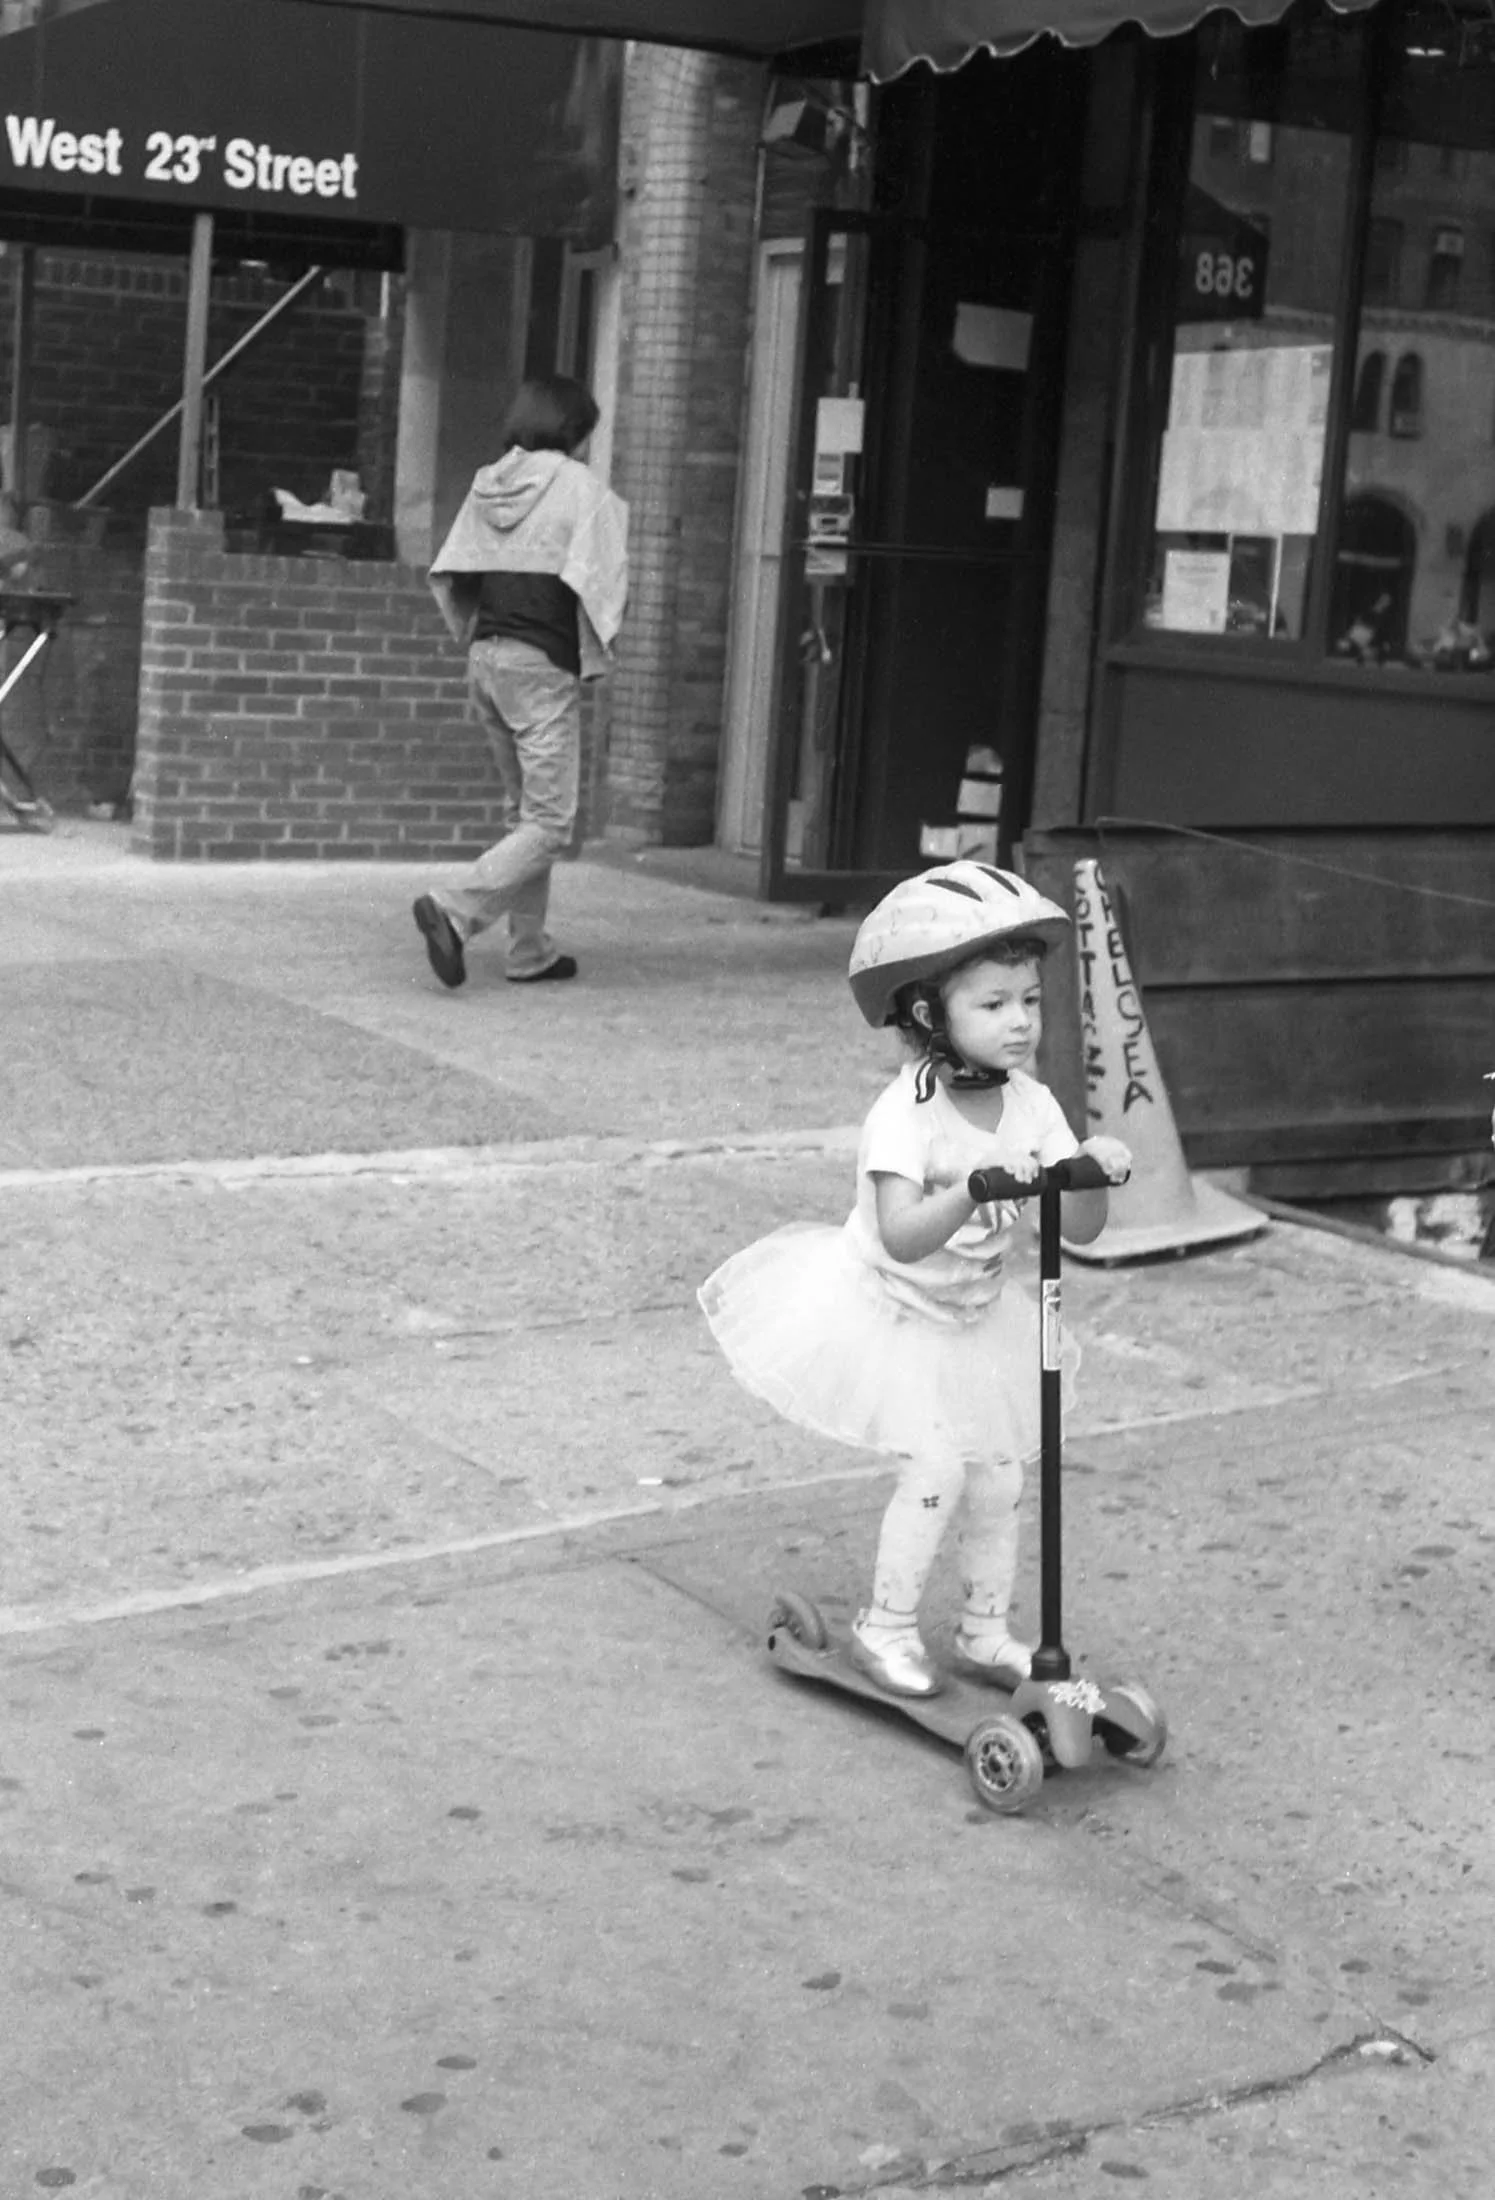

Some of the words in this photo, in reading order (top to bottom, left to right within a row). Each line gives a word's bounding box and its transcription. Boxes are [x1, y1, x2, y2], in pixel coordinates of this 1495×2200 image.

[5, 114, 122, 175] West
[144, 131, 217, 183] 23rd
[223, 138, 359, 198] Street
